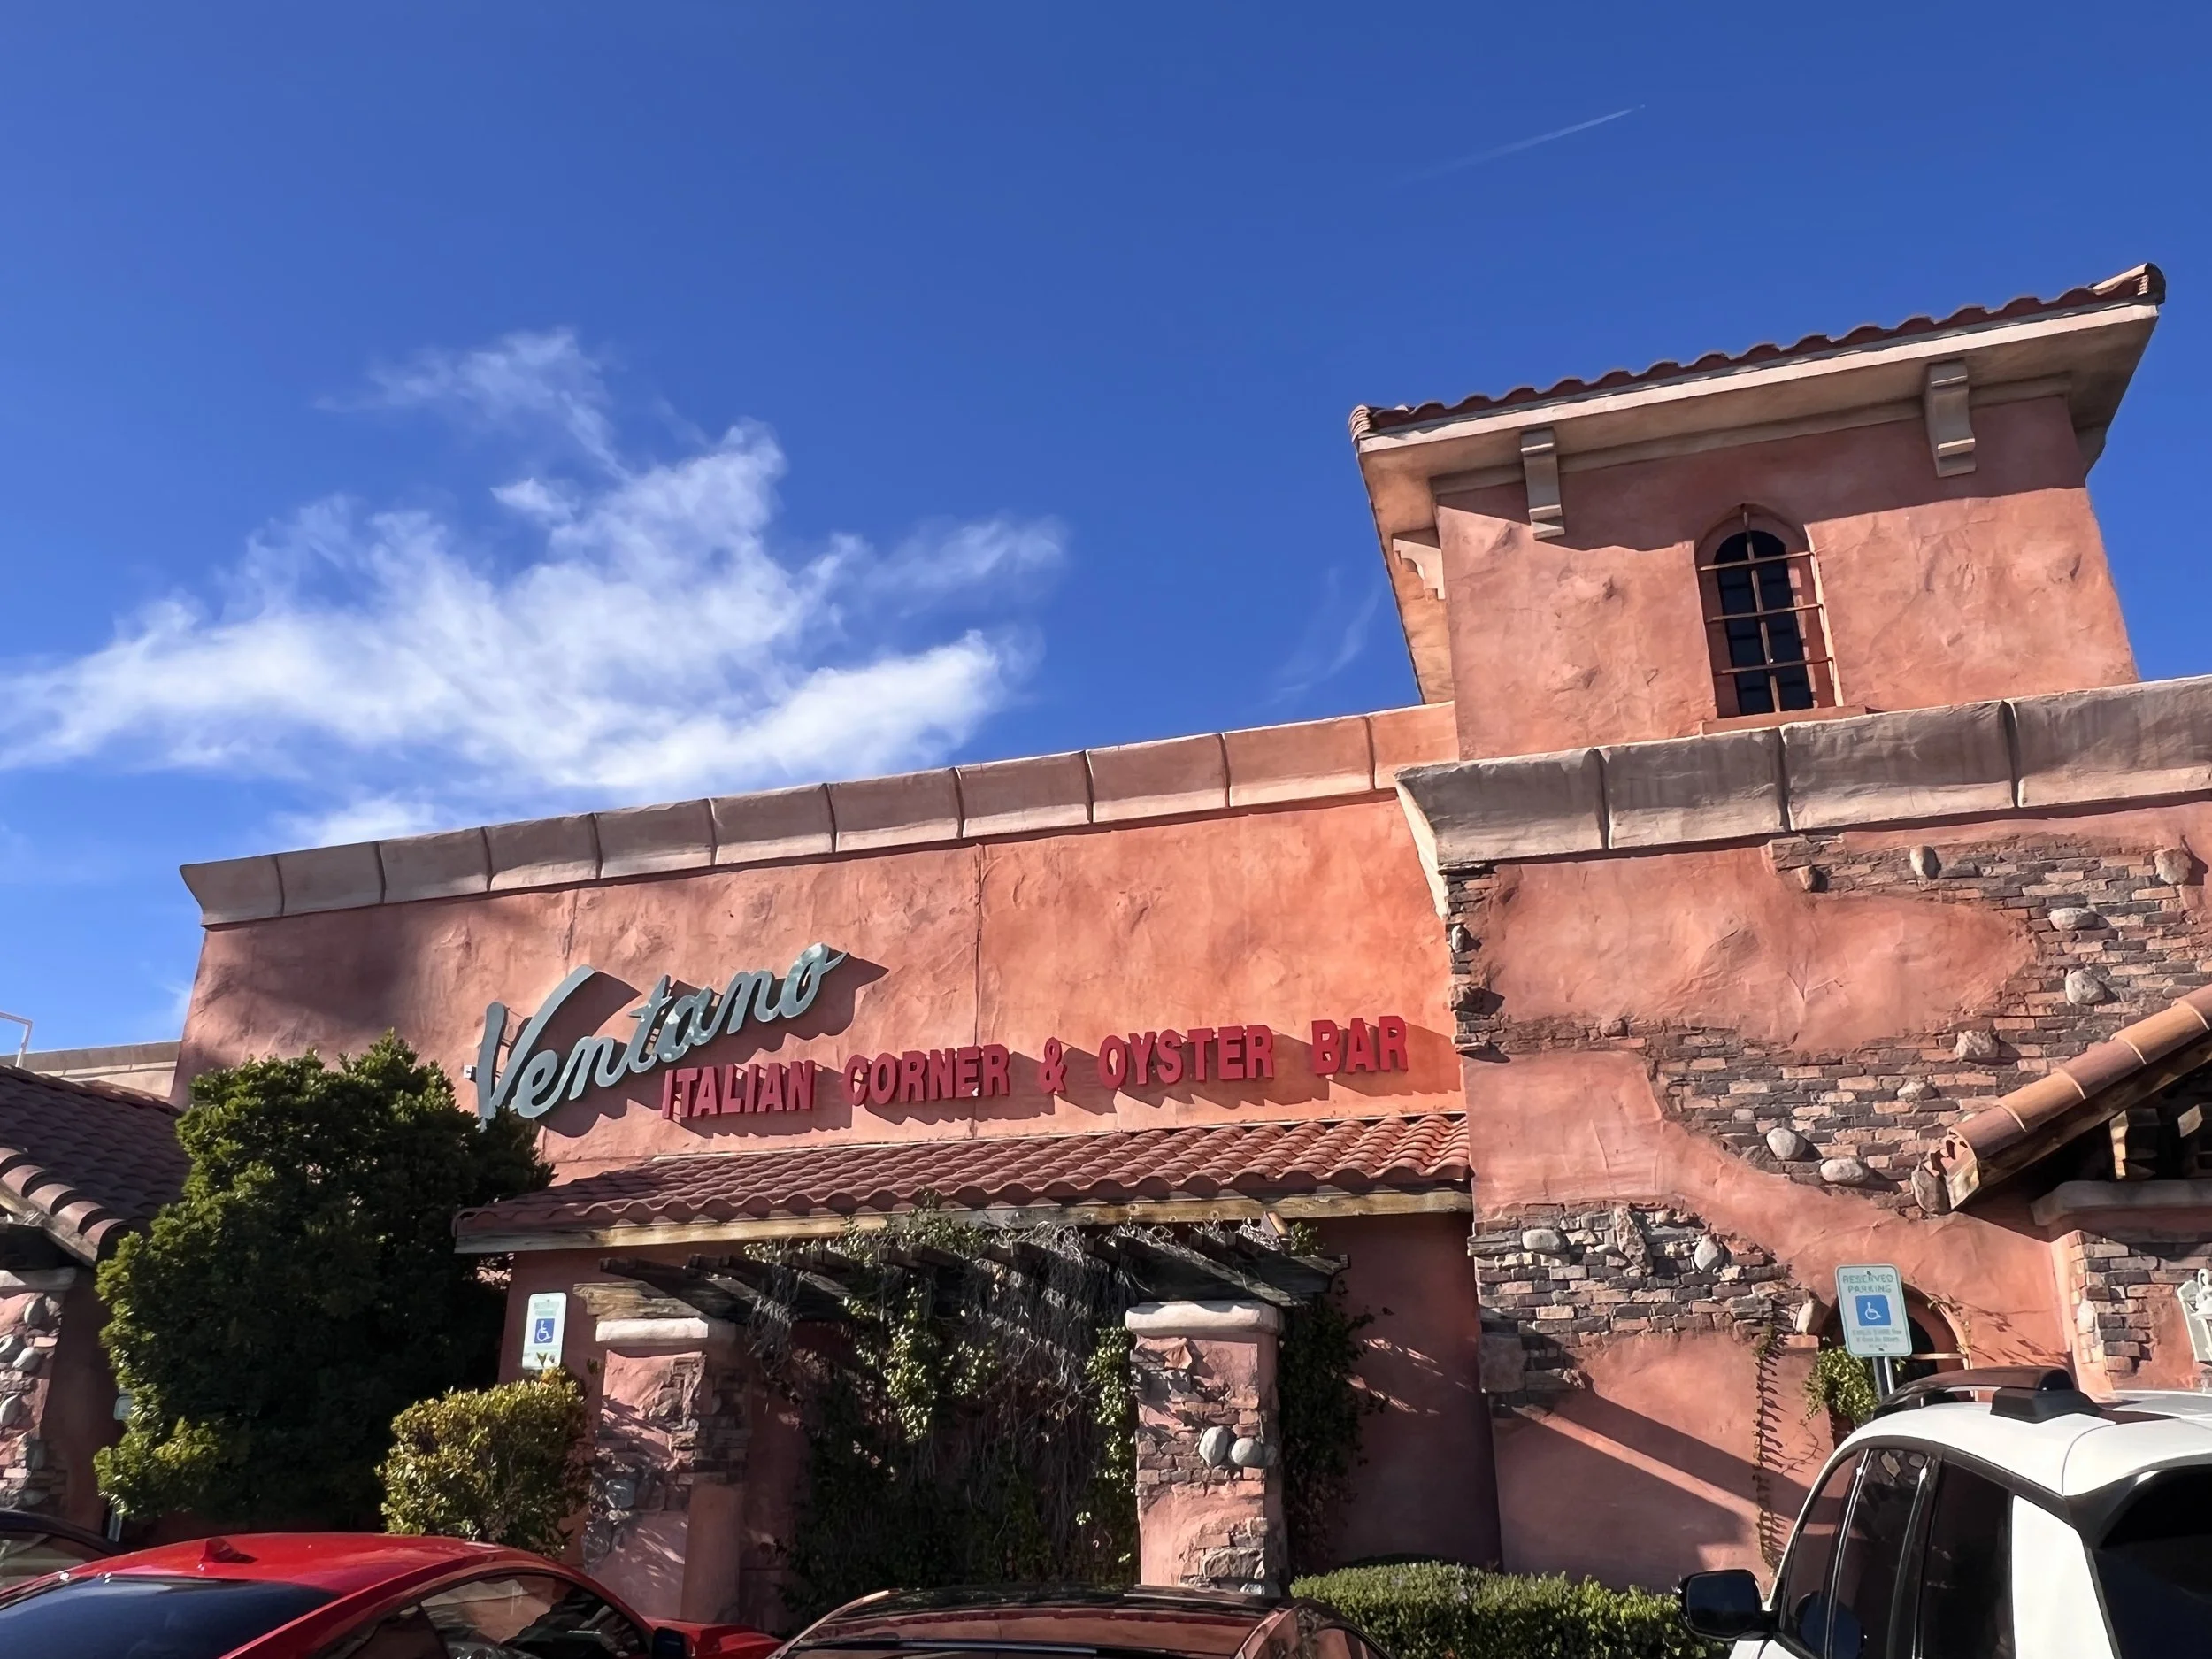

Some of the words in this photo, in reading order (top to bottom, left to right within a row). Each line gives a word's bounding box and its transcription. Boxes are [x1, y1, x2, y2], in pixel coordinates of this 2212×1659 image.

[476, 942, 848, 1125] Ventano
[662, 1060, 815, 1120] ITALIAN
[842, 1044, 1010, 1106] CORNER
[1038, 1036, 1067, 1094] &
[1098, 1025, 1274, 1089] OYSTER
[1311, 1015, 1409, 1076] BAR
[1842, 1274, 1894, 1285] RESERVED
[1847, 1285, 1892, 1294] PARKING
